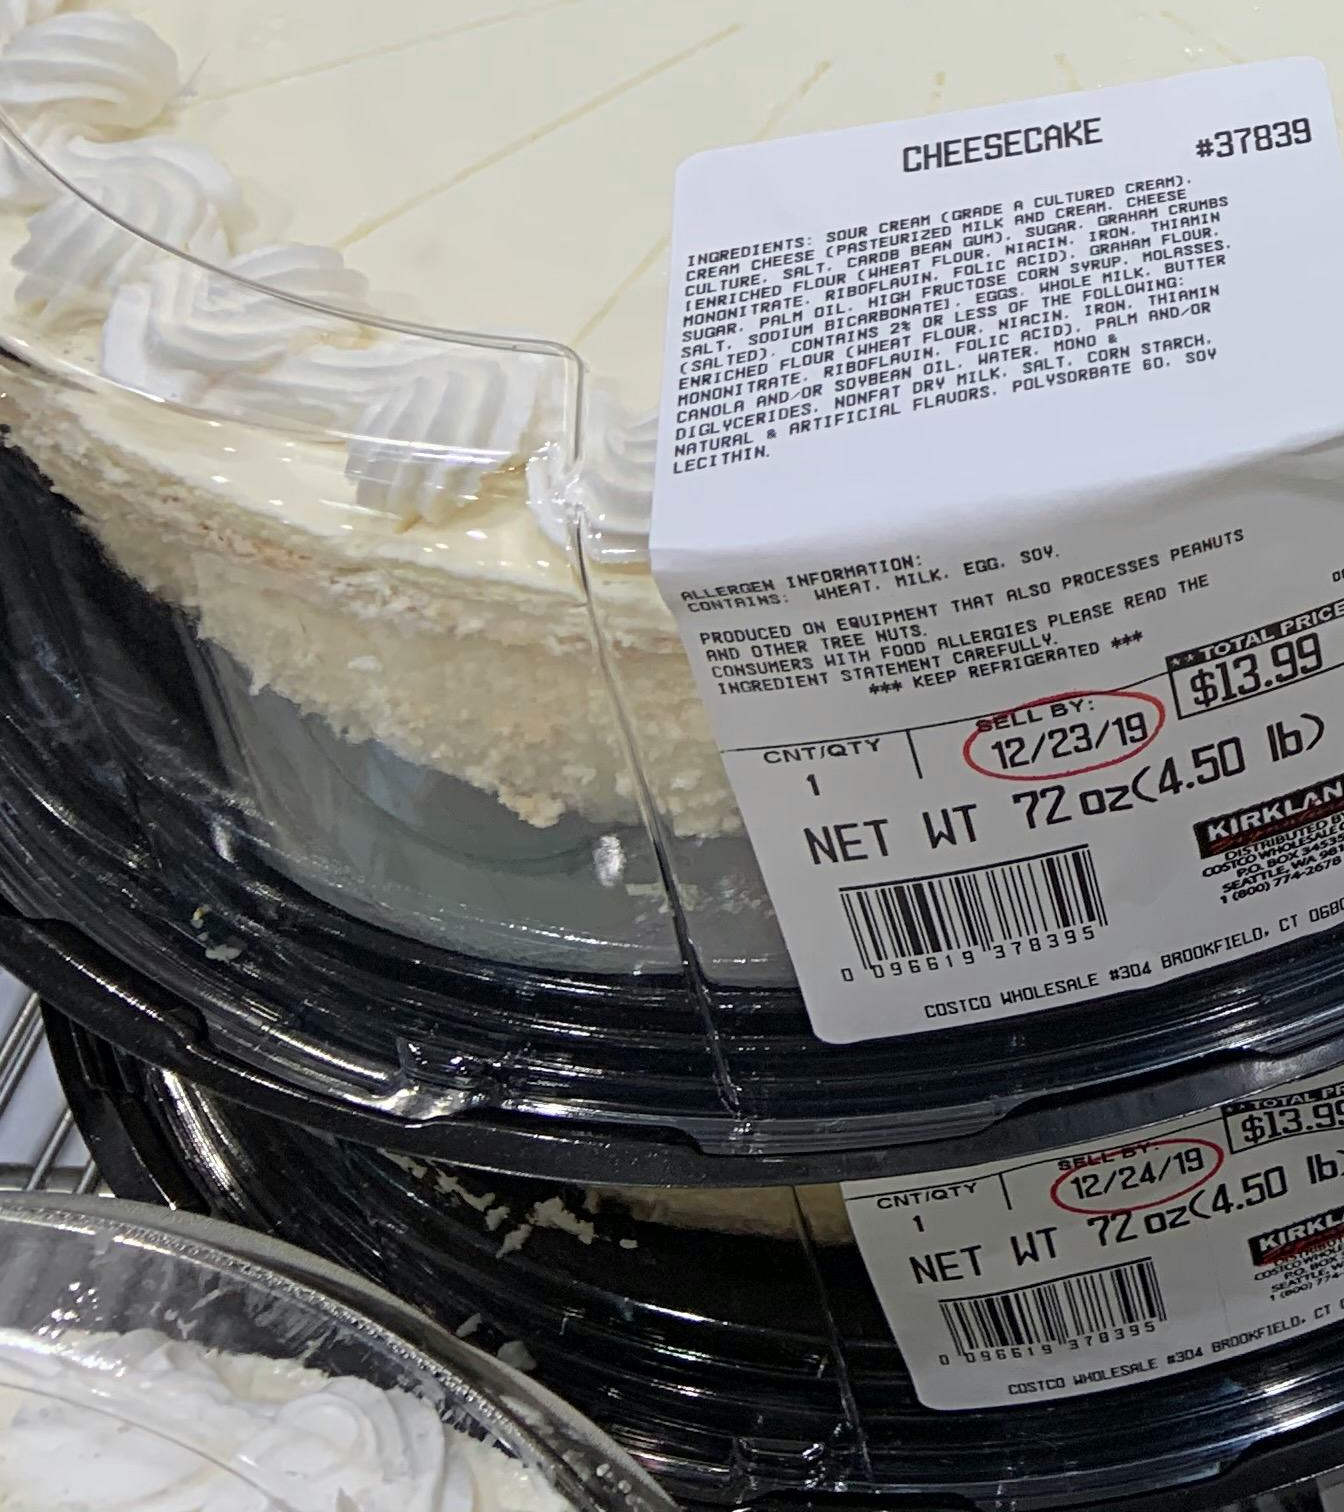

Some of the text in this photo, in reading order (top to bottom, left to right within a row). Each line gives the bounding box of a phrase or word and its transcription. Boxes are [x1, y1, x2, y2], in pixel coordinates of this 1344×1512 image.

[903, 117, 1103, 172] CHEESECAKE
[1196, 118, 1312, 158] #37839
[686, 262, 740, 282] CREAM
[751, 249, 815, 271] CHEESE
[826, 225, 952, 258] (PASTEURIZED
[962, 217, 1004, 234] MILK
[1014, 211, 1045, 226] AND
[1126, 188, 1187, 208] CHEESE
[688, 237, 811, 267] INGREDIENTS:
[826, 225, 868, 243] SOUR
[878, 214, 931, 234] CREAM
[941, 203, 1003, 224] (GRADE
[1013, 200, 1024, 212] A
[1034, 186, 1115, 209] CULTURED
[680, 555, 922, 602] ALLERGEN INFORMATION:
[699, 528, 1244, 645] PRODUCED ON EQUIPMENT THAT ALSO PROCESSES PEANUTS
[687, 593, 788, 613] CONTAINS:
[711, 574, 1209, 678] CONSUMERS WITH FOOD ALLERGIES PLEASE READ THE
[706, 624, 927, 662] AND OTHER TREE NUTS.
[718, 634, 1058, 695] INGREDIENT STATEMENT CAREFULLY.
[912, 642, 1100, 689] KEEP REFRIGERATED
[1200, 629, 1274, 661] TOTAL
[1190, 632, 1322, 707] $13.99
[975, 698, 1096, 733] SELL BY:
[763, 738, 880, 764] CNT/QTY
[992, 711, 1149, 770] 12/23/19
[803, 818, 889, 865] NET
[923, 804, 977, 849] WT
[1012, 785, 1072, 829] 72
[1269, 711, 1326, 764] lb)
[806, 774, 820, 796] 1
[1202, 855, 1256, 877] COSTCO
[1258, 828, 1338, 859] WHOLESALE
[1225, 819, 1328, 861] DISTRIBUTED
[1267, 850, 1299, 868] BOX
[1292, 853, 1317, 870] WA
[1220, 895, 1227, 904] 1
[1232, 881, 1271, 901] (800)
[1274, 858, 1342, 888] 774-2678
[924, 995, 992, 1019] COSTCO
[1001, 972, 1100, 1008] WHOLESALE
[1108, 960, 1152, 982] #304
[1279, 913, 1300, 932] CT
[994, 926, 1096, 960] 378395
[1252, 1092, 1316, 1110] TOTAL
[877, 1183, 978, 1210] CNT/QTY
[1070, 1147, 1205, 1200] 12/24/19
[909, 1245, 983, 1284] NET
[1011, 1227, 1058, 1266] WT
[1087, 1210, 1138, 1247] 72
[913, 1216, 925, 1233] 1
[1008, 1376, 1066, 1395] COSTCO
[1073, 1358, 1158, 1386] WHOLESALE
[1314, 1303, 1331, 1320] CT
